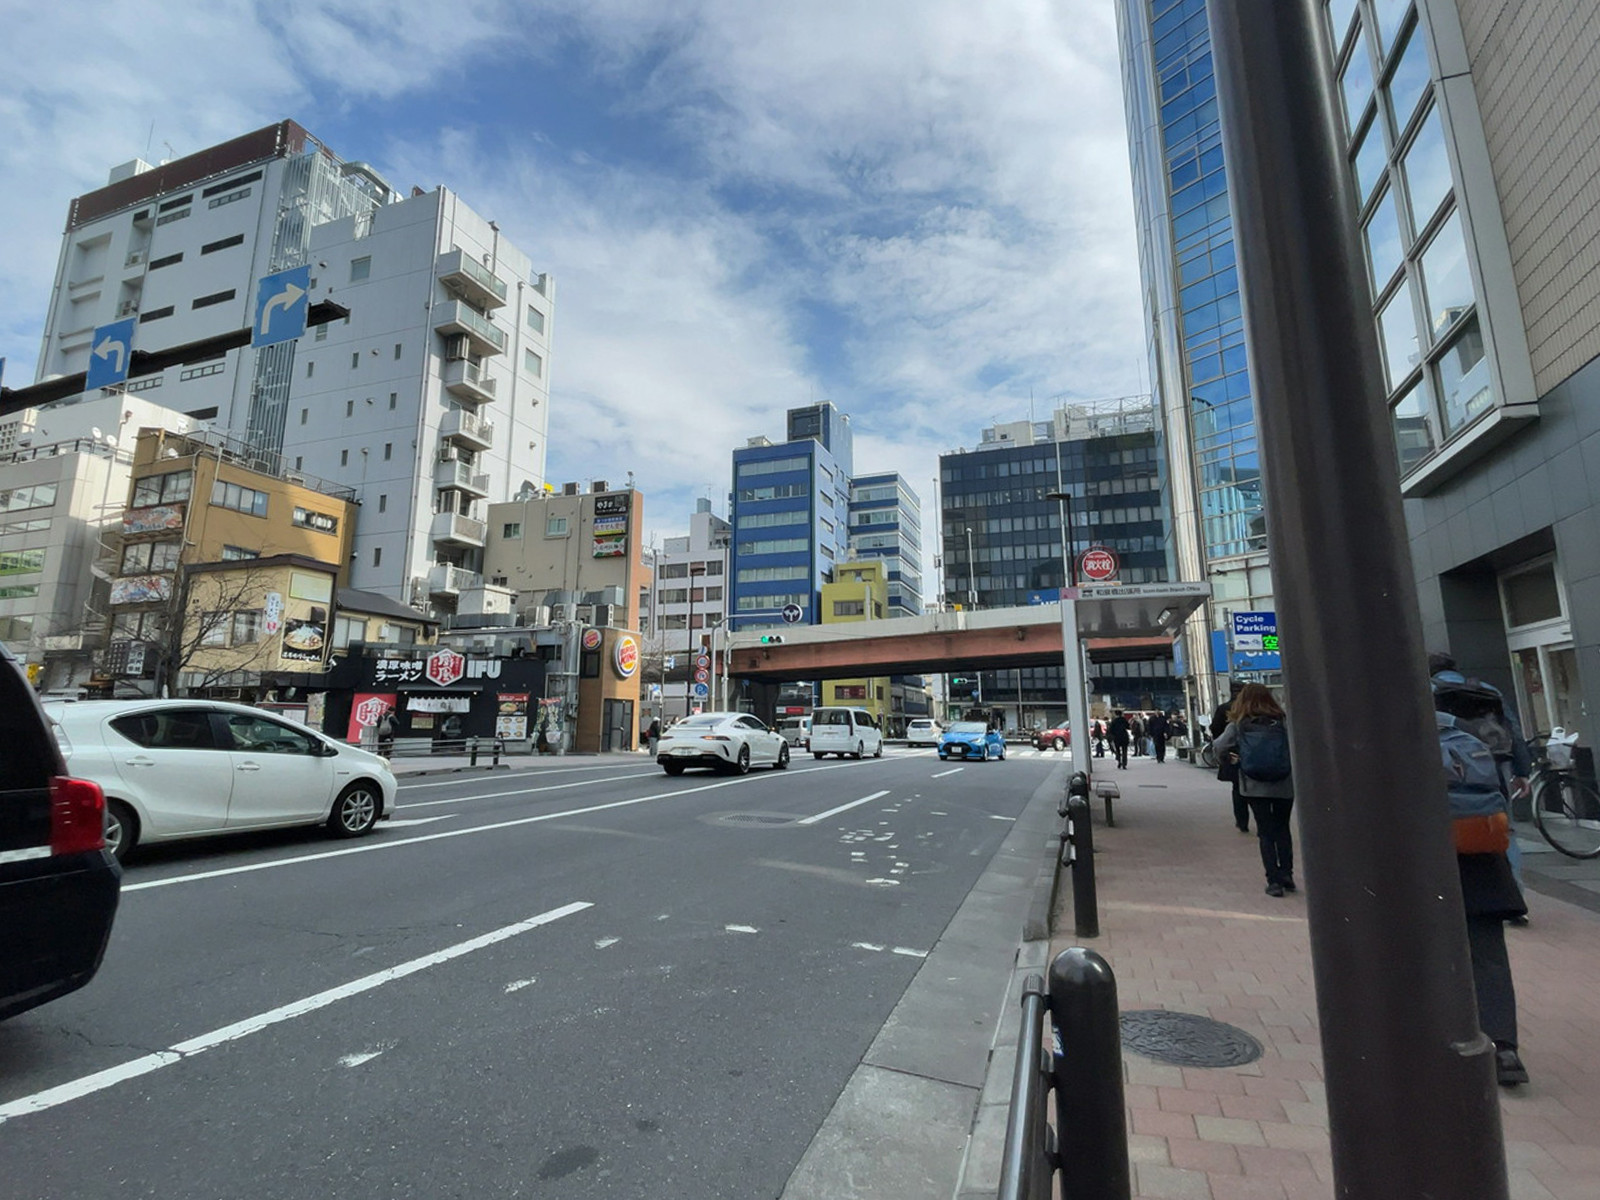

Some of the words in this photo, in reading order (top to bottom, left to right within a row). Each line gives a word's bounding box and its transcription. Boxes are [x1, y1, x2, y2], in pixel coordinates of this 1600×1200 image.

[1085, 559, 1111, 571] 消火栓
[1235, 615, 1264, 624] Cycle
[1236, 624, 1276, 633] Parking
[1262, 635, 1280, 650] 空
[620, 652, 636, 664] KING
[376, 660, 423, 670] 濃厚味噌
[467, 660, 501, 678] IFU
[375, 670, 422, 682] ラーメン
